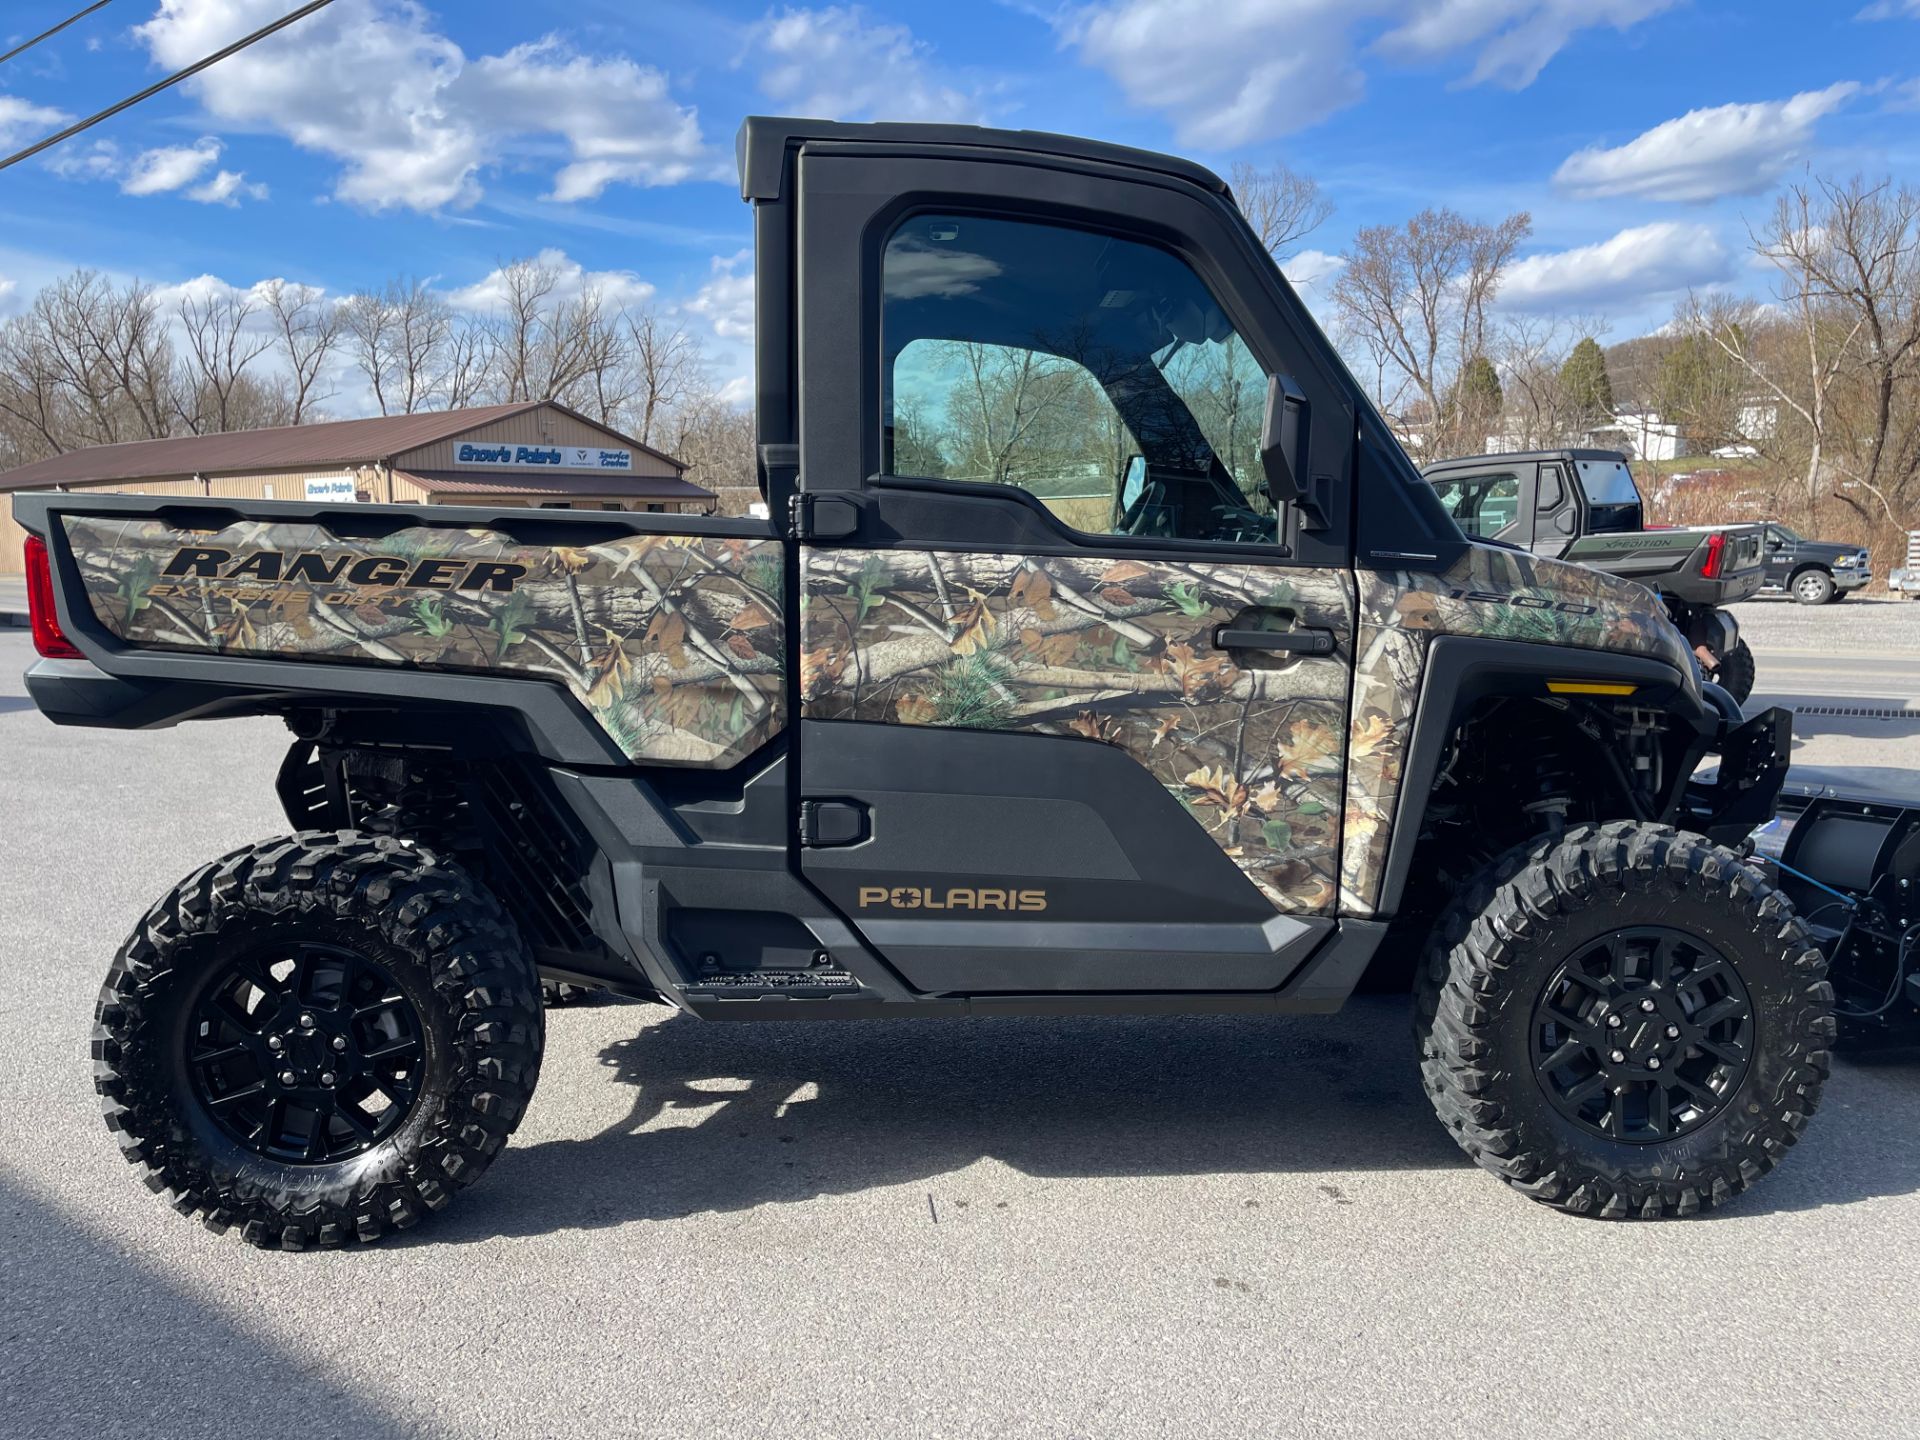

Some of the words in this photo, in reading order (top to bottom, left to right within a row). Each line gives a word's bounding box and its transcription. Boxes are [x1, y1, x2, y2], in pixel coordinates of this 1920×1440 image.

[515, 447, 561, 464] Polaris
[1601, 539, 1672, 550] XPEDITION
[160, 546, 529, 593] RANGER
[146, 584, 313, 603] EXTREME
[1450, 589, 1597, 615] 1500
[859, 887, 1047, 911] POLARIS
